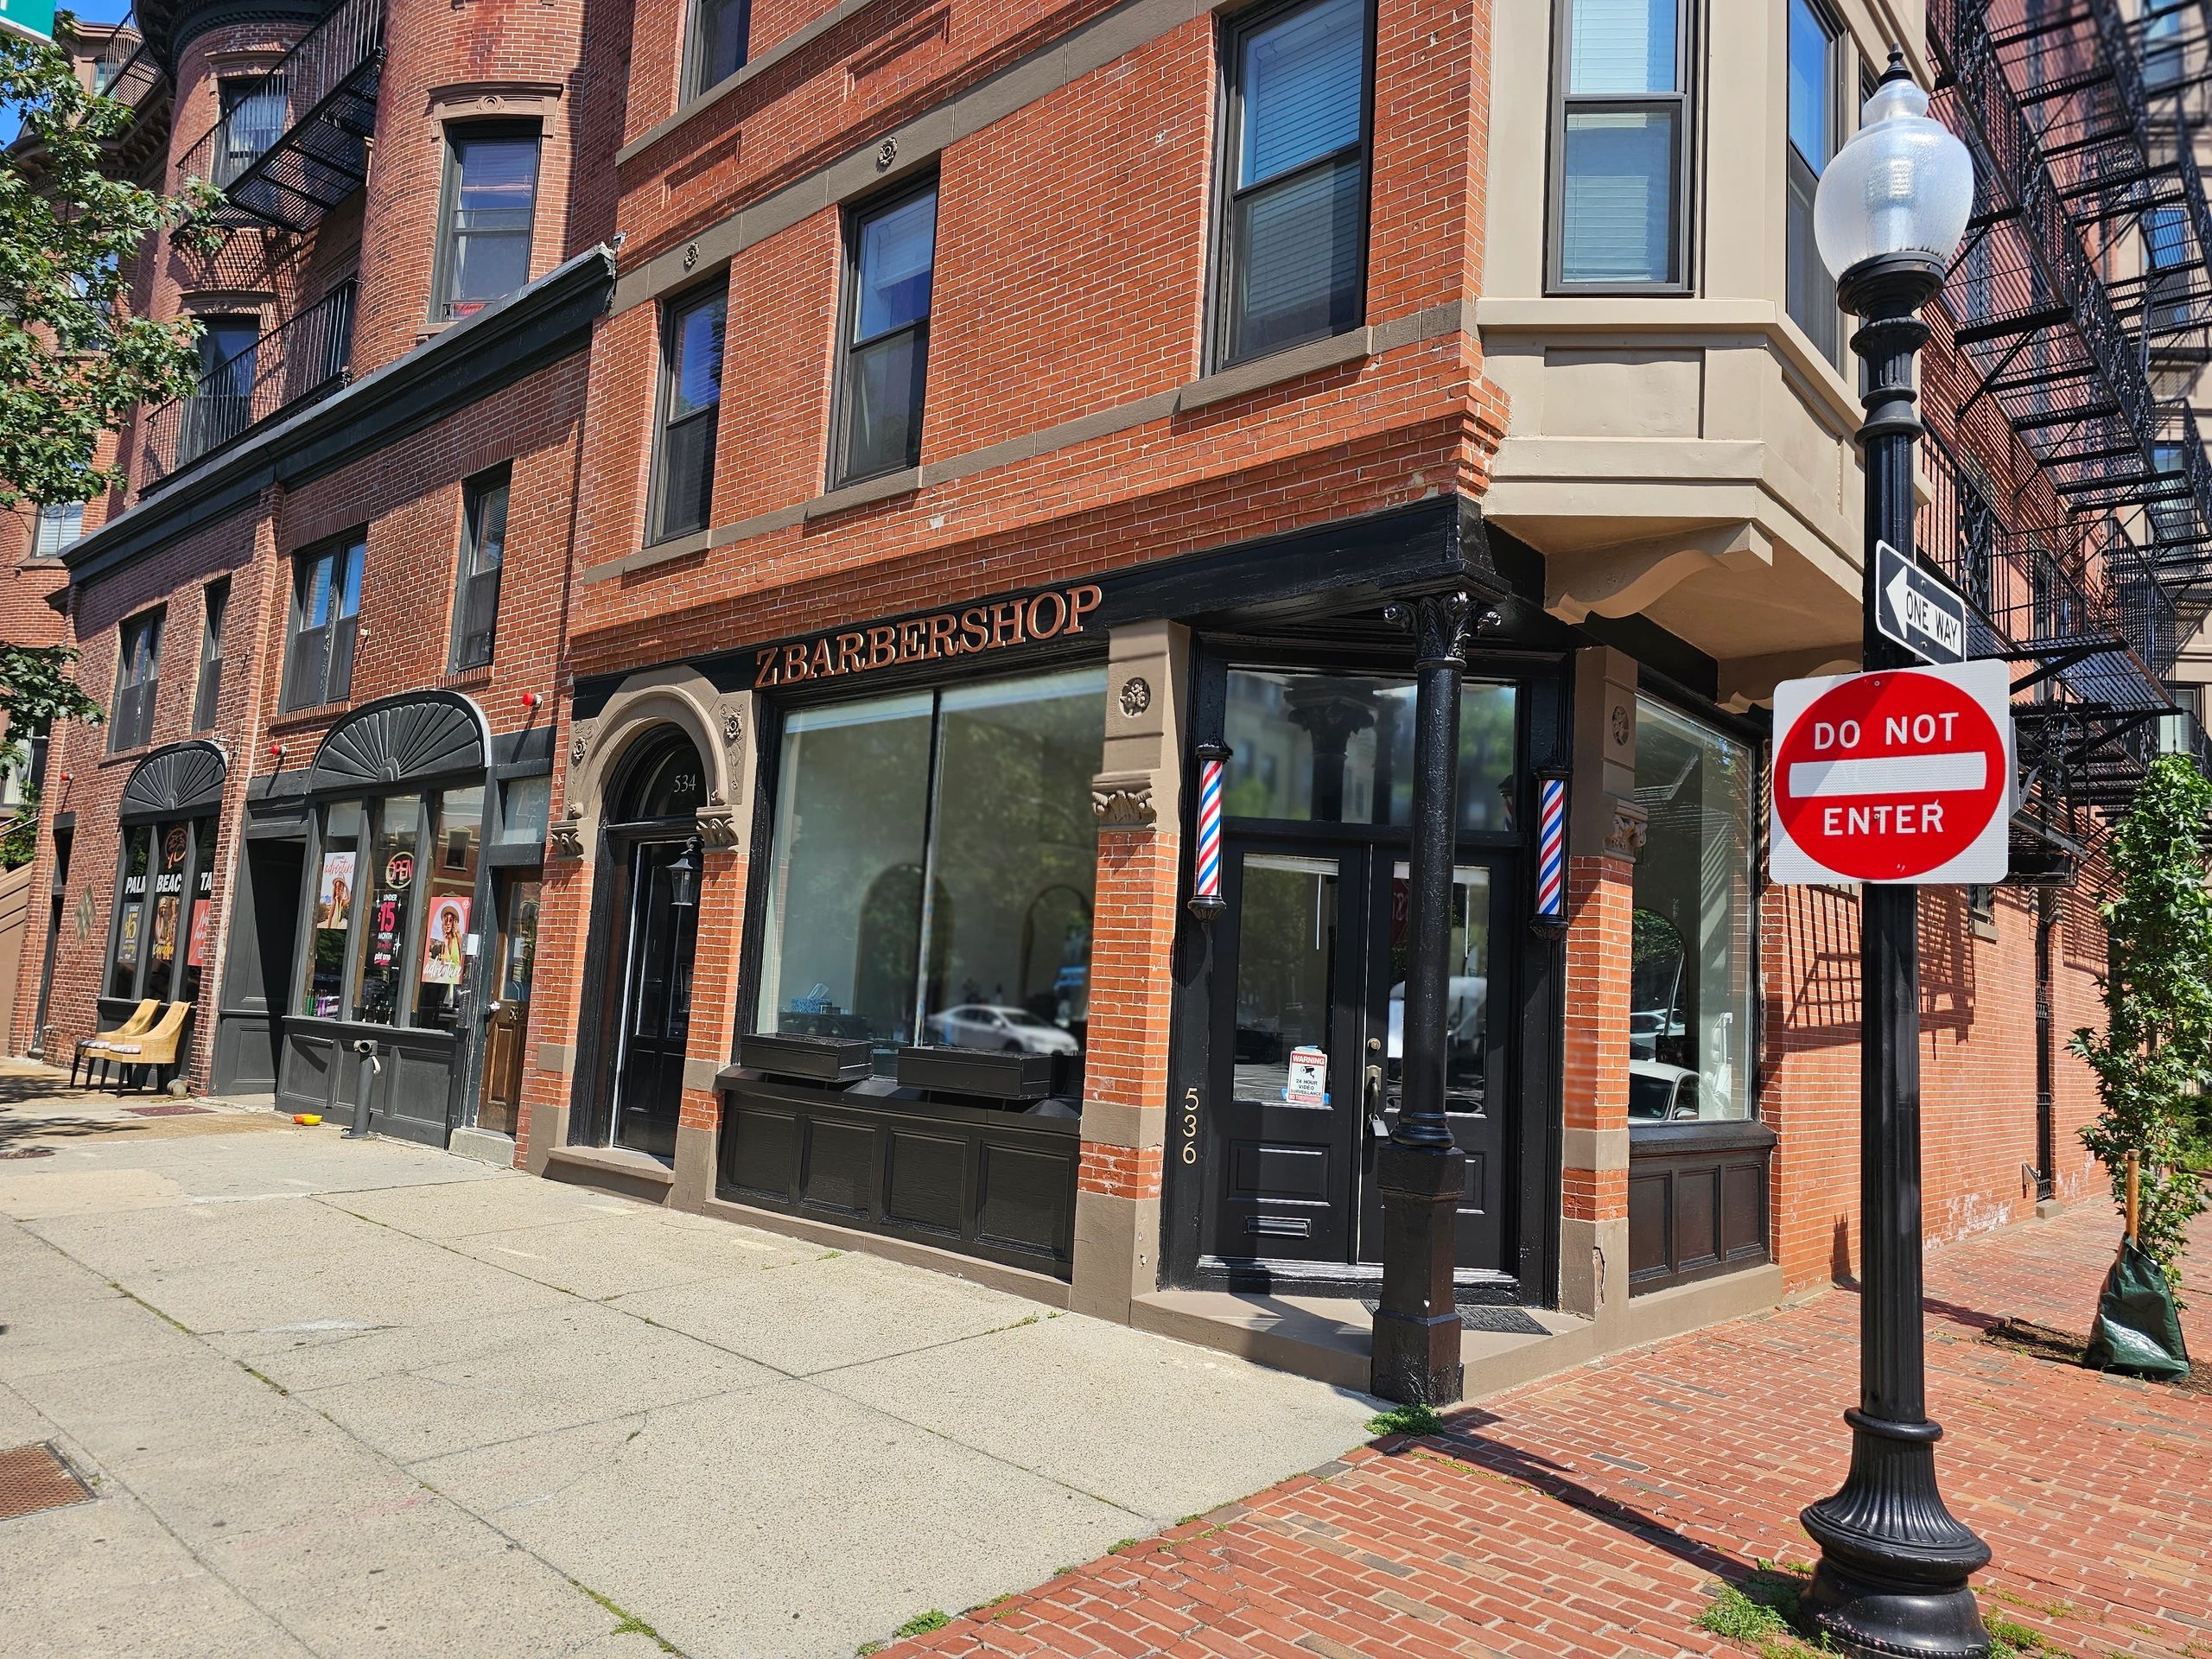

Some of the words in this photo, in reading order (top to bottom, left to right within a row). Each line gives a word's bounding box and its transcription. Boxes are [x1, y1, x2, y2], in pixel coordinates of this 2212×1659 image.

[1906, 590, 1929, 632] ONE
[1936, 609, 1957, 649] WAY
[1815, 720, 1860, 750] DO
[1885, 712, 1959, 746] NOT
[674, 773, 696, 792] 534
[1823, 804, 1944, 836] ENTER
[156, 873, 182, 893] BEAC
[200, 871, 213, 891] TA
[388, 859, 415, 883] OPEN
[1293, 1055, 1325, 1065] WARNING
[1182, 1087, 1199, 1165] 536
